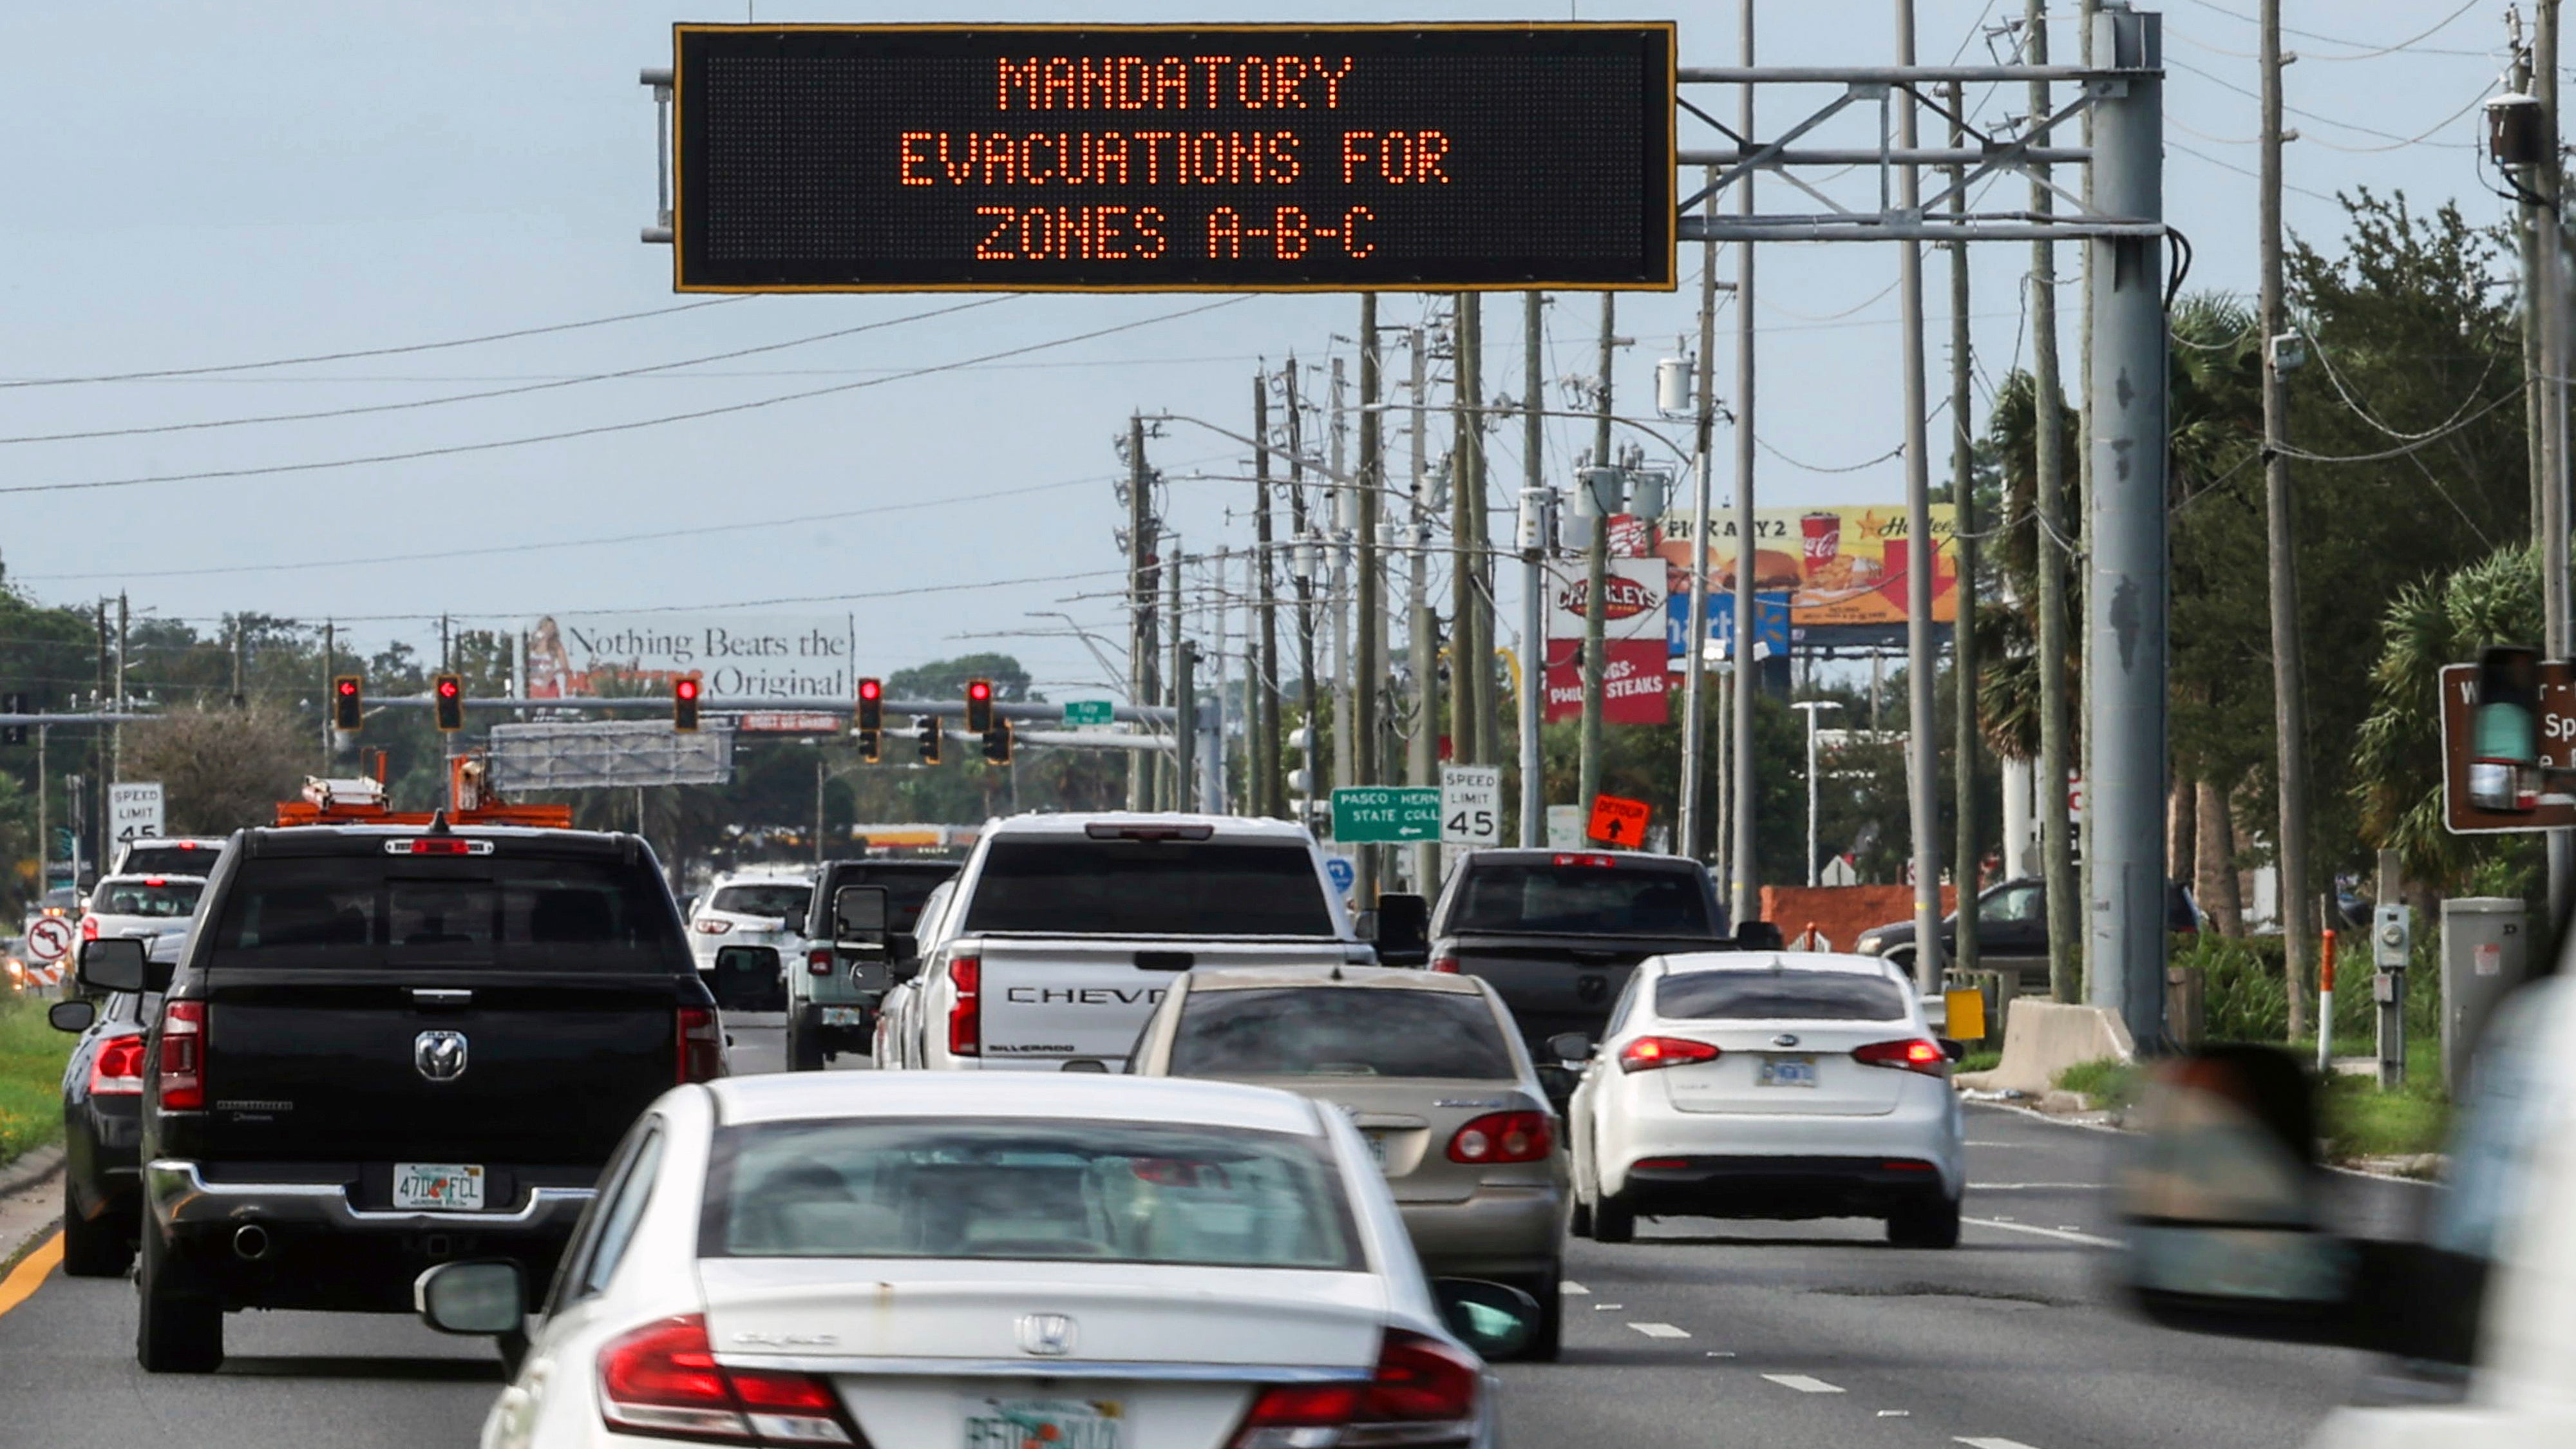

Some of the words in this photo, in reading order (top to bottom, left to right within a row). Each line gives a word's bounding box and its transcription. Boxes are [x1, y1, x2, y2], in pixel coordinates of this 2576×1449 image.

[999, 57, 1352, 109] MANDATORY
[902, 131, 1300, 185] EVACUATIONS
[1343, 131, 1448, 184] FOR
[976, 206, 1165, 260] ZONES
[1209, 206, 1374, 260] A-B-C
[1723, 520, 1770, 537] AY
[1774, 520, 1786, 536] 2
[1556, 583, 1661, 611] CHLEYS
[569, 627, 694, 664] Nothing
[705, 628, 789, 657] Beats
[799, 629, 845, 656] the
[712, 666, 842, 698] Original
[1606, 676, 1663, 699] STEAKS
[1446, 774, 1495, 786] SPEED
[114, 790, 158, 802] SPEED
[1341, 793, 1388, 804] PASCO
[1452, 793, 1489, 804] LIMIT
[119, 806, 153, 819] LIMIT
[1353, 808, 1396, 822] STATE
[1446, 811, 1493, 836] 45
